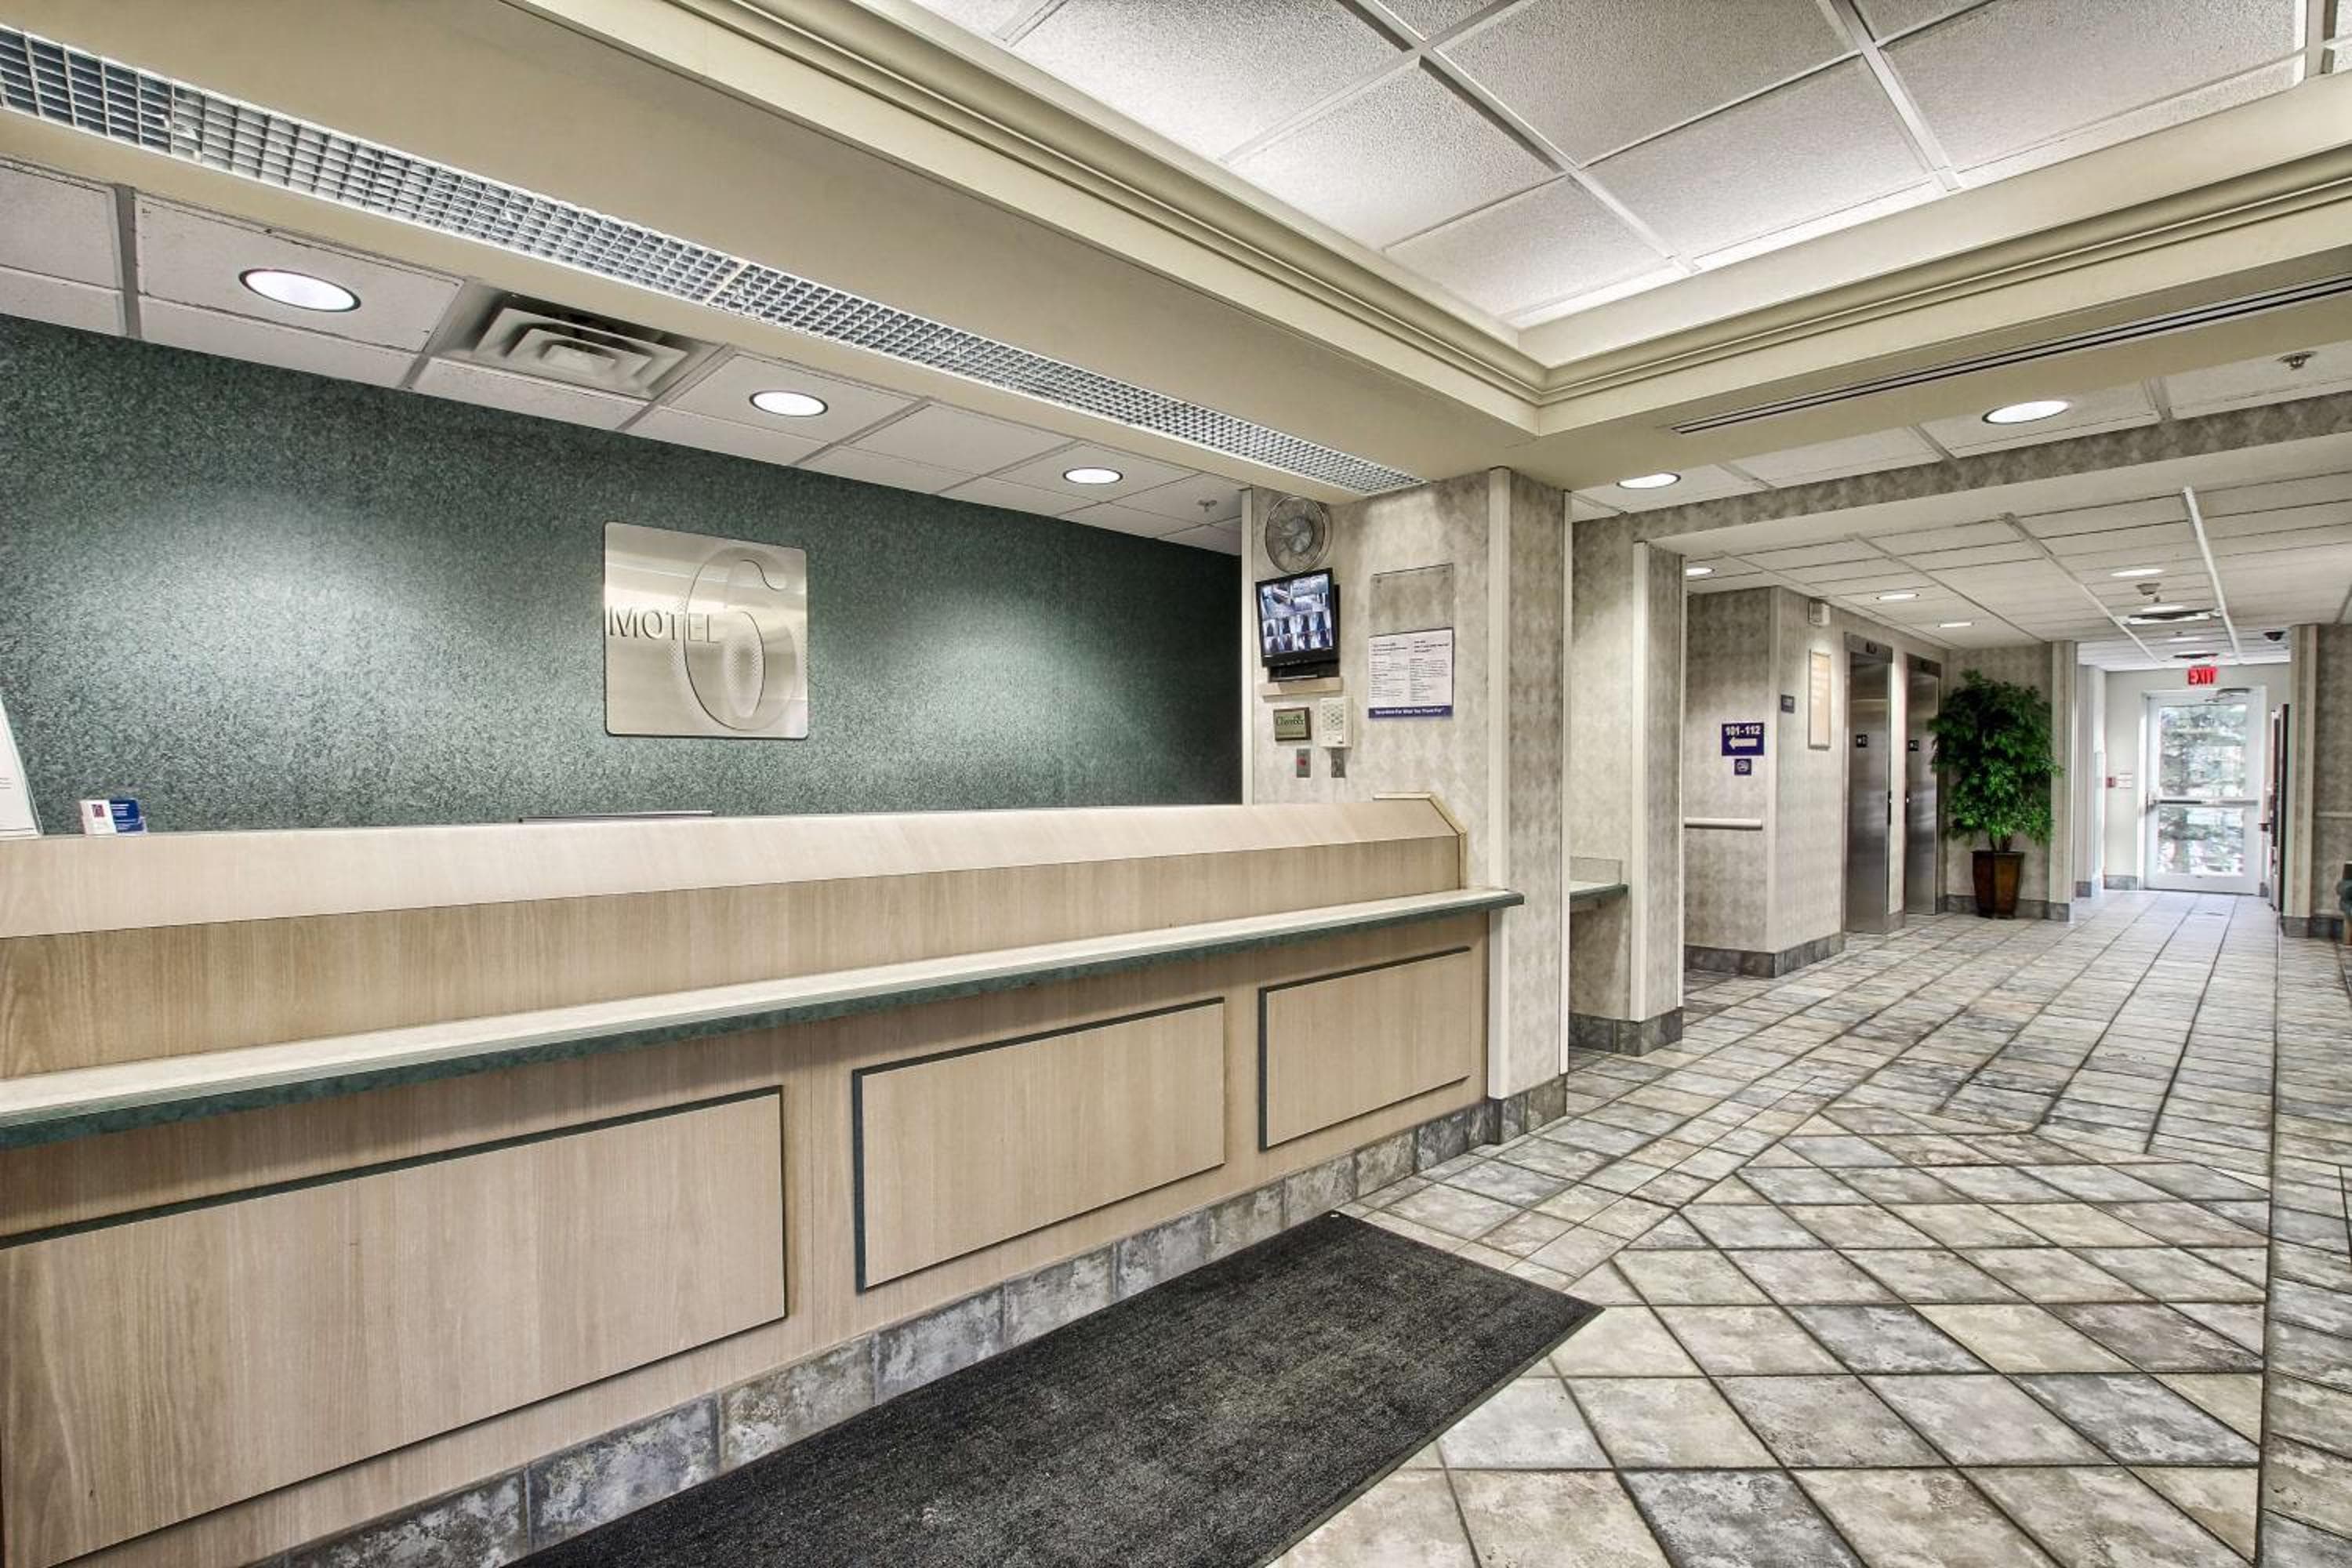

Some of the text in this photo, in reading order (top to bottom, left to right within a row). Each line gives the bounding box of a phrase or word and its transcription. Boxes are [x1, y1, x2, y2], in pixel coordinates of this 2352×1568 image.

[608, 549, 797, 731] MOTEL 6
[2188, 669, 2215, 684] EXIT
[1726, 725, 1761, 735] 101-112
